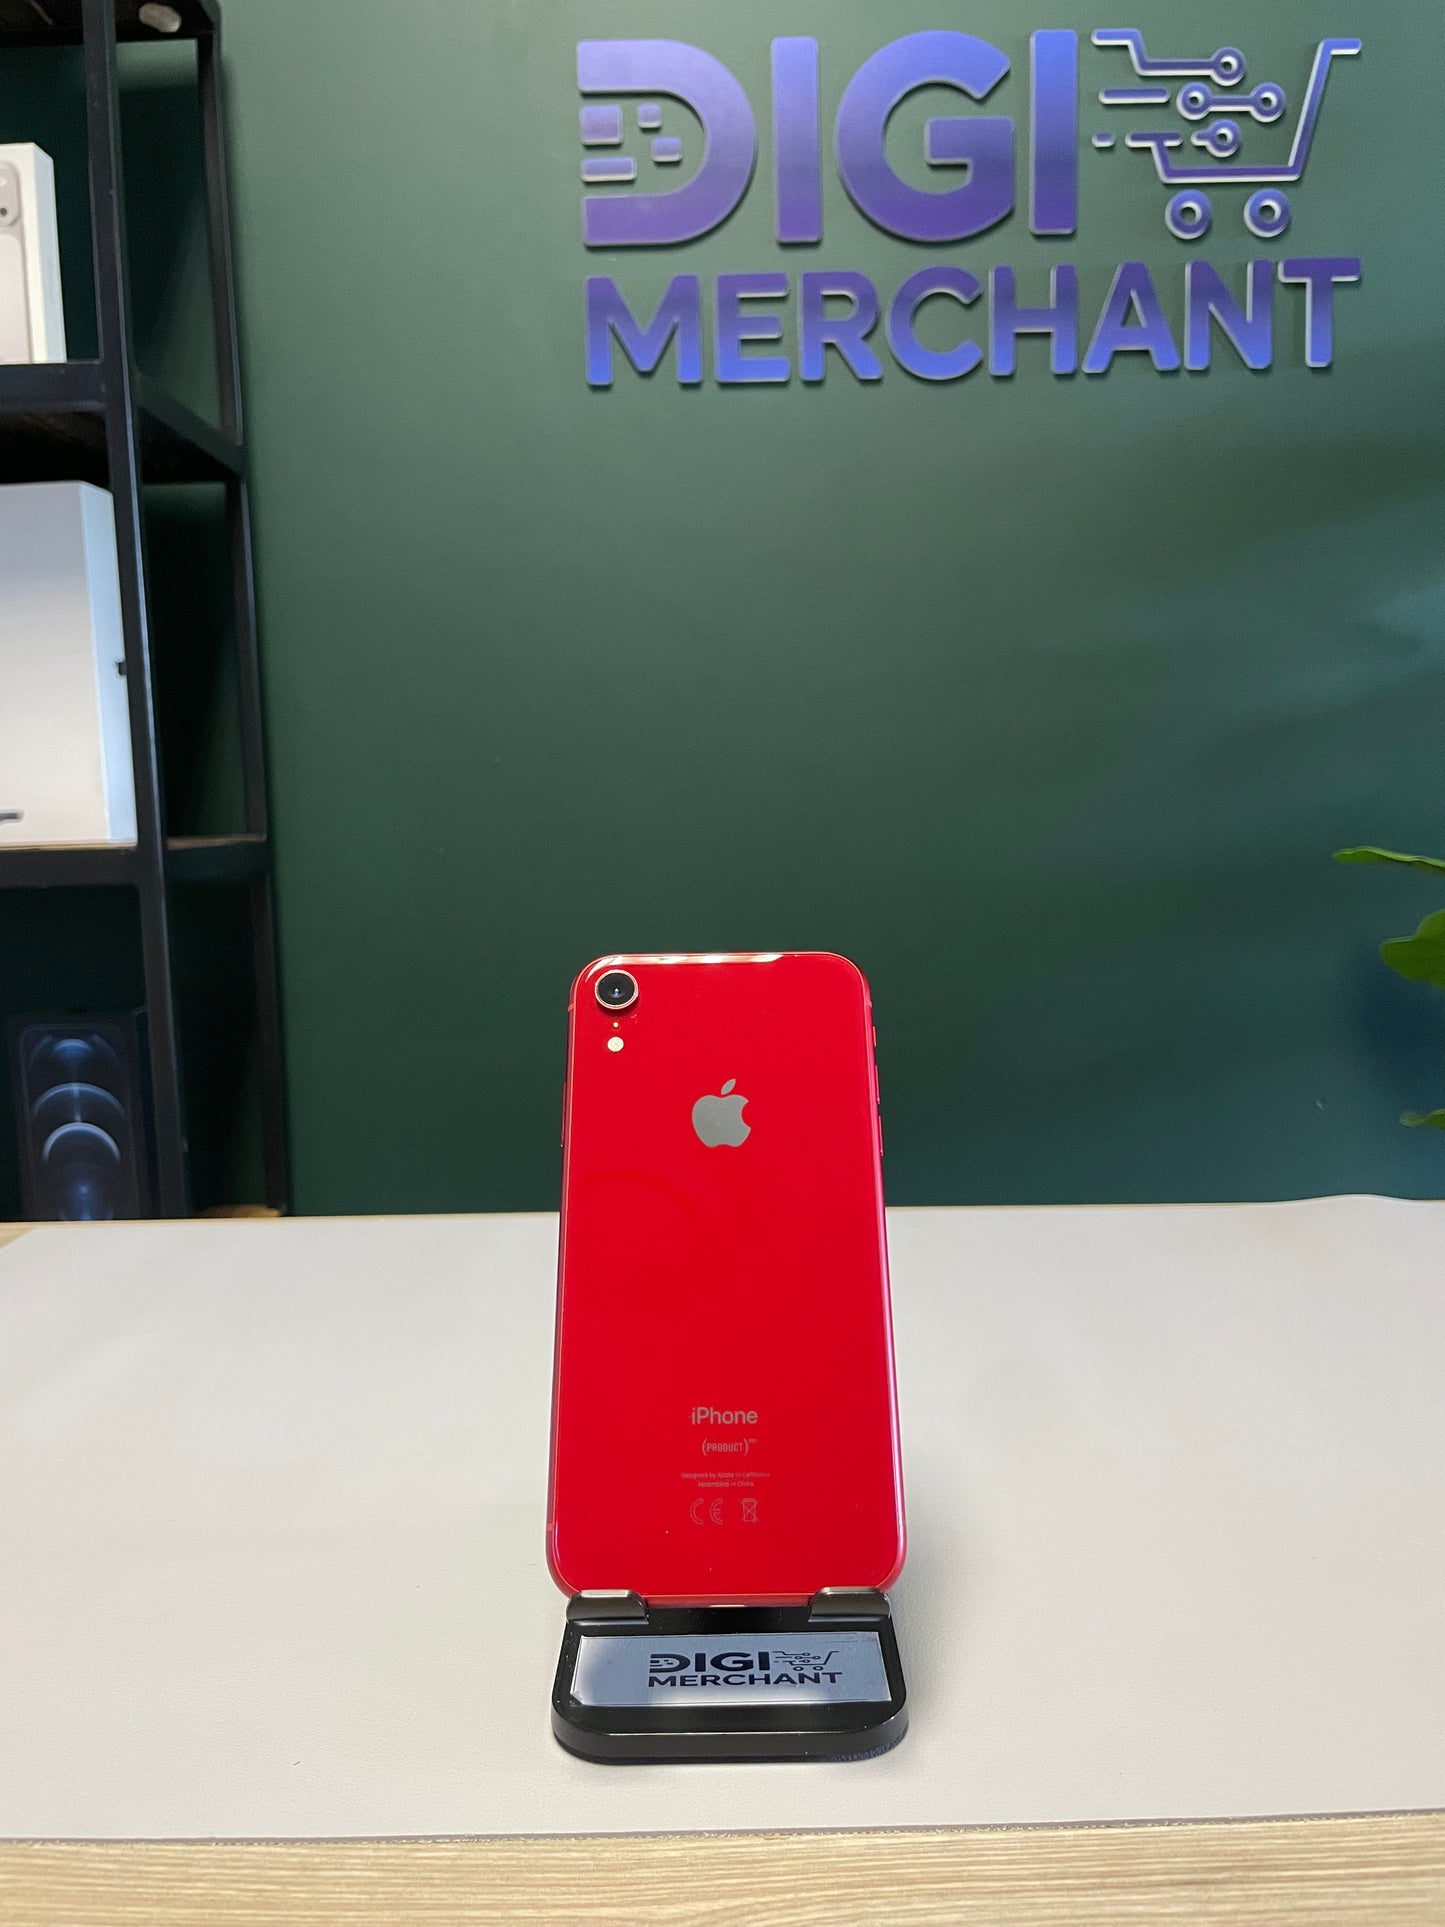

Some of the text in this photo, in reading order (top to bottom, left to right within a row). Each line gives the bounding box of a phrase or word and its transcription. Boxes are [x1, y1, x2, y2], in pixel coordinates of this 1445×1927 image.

[577, 29, 1078, 247] DIGI
[585, 257, 1361, 387] MERCHANT
[691, 1406, 758, 1425] iPhone
[690, 1498, 724, 1525] CE
[649, 1651, 771, 1672] DIGI
[648, 1672, 843, 1688] MERCHANT
